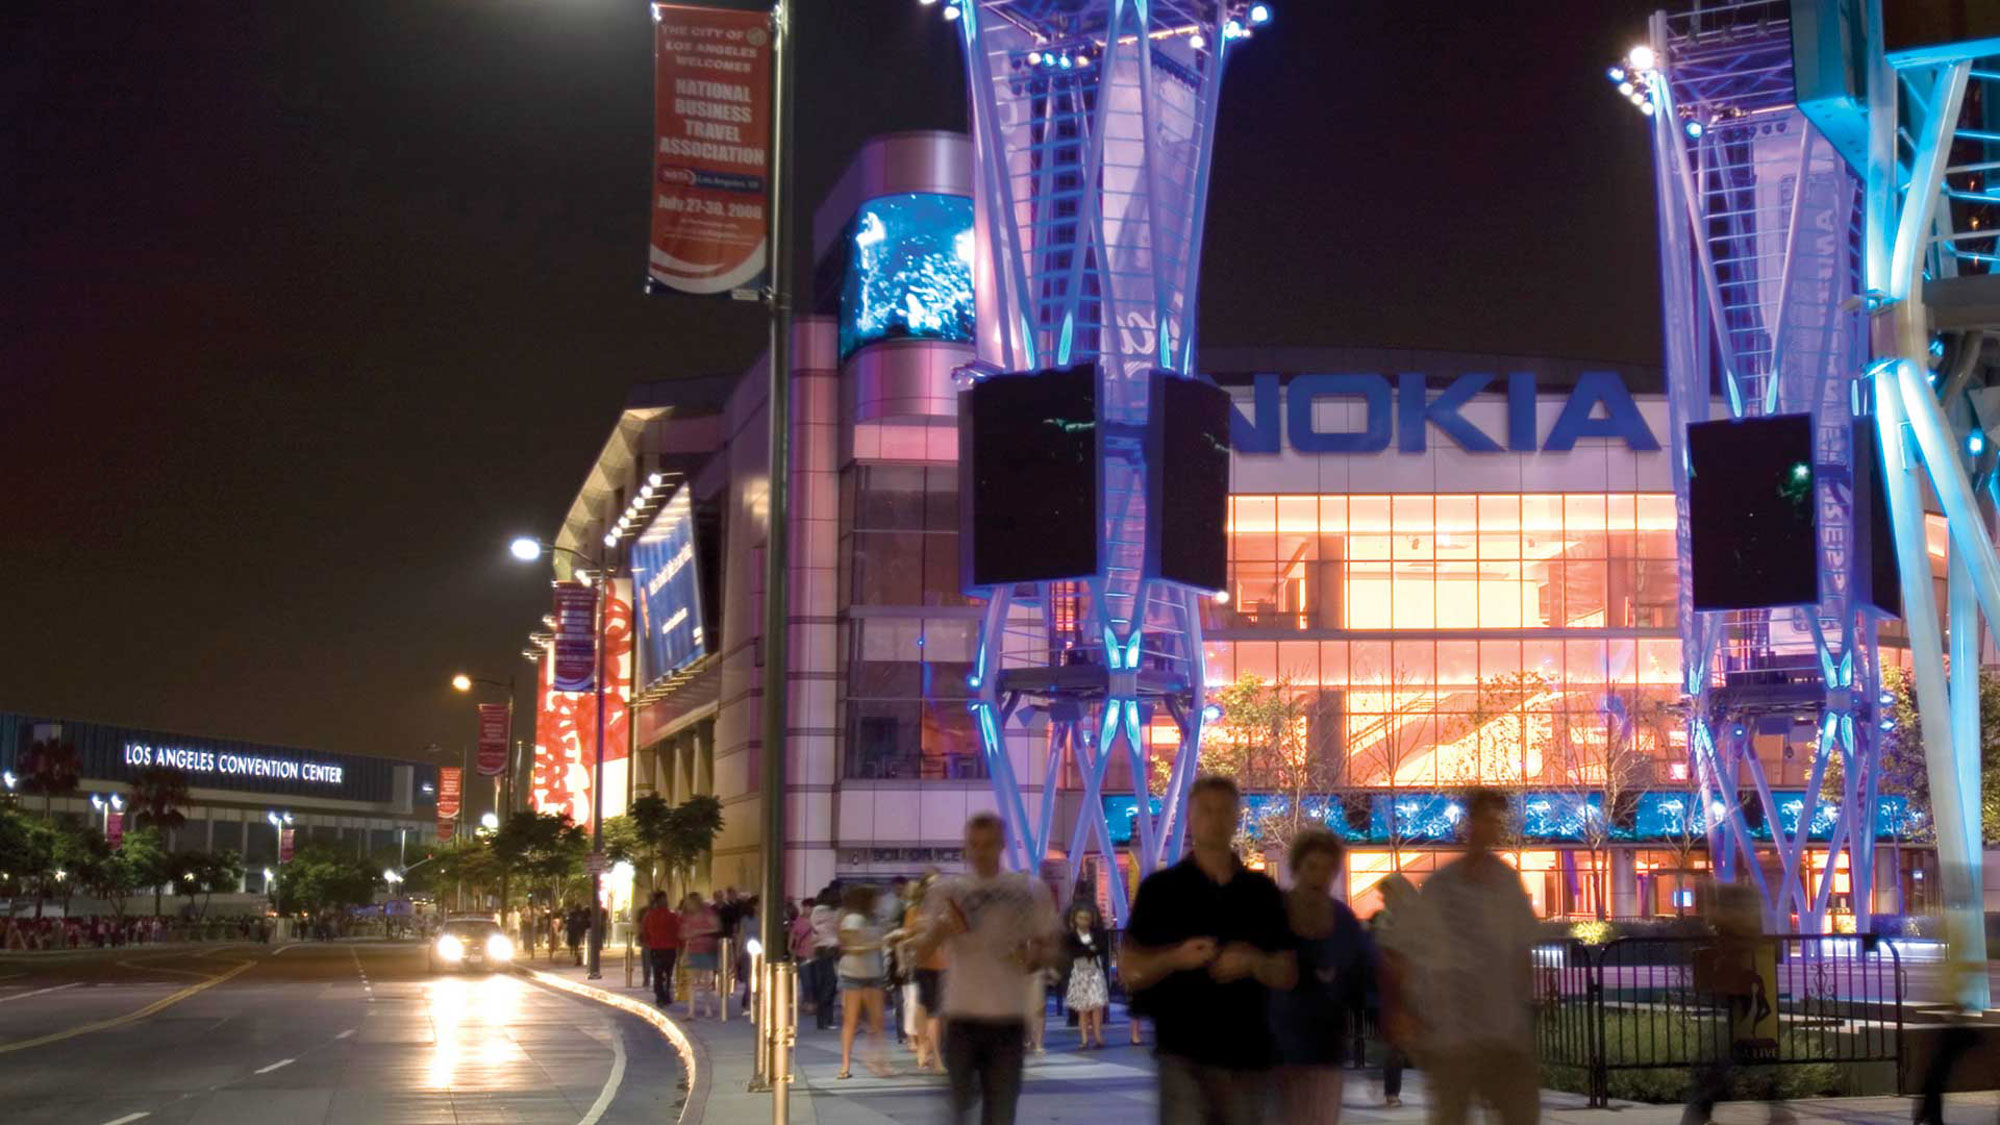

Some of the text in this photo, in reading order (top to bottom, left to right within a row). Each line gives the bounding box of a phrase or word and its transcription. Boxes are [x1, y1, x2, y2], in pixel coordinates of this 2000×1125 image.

[661, 24, 745, 40] THE CITY OF
[665, 40, 758, 58] LOS ANGELES
[676, 54, 752, 73] WELCOMES
[675, 79, 752, 103] NATIONAL
[674, 98, 752, 124] BUSINESS
[684, 119, 742, 143] TRAVEL
[659, 136, 766, 165] ASSOCIATION
[658, 194, 684, 212] July
[1199, 372, 1662, 453] NOKIA
[126, 744, 343, 784] LOS ANGELES CONVENTION CENTER
